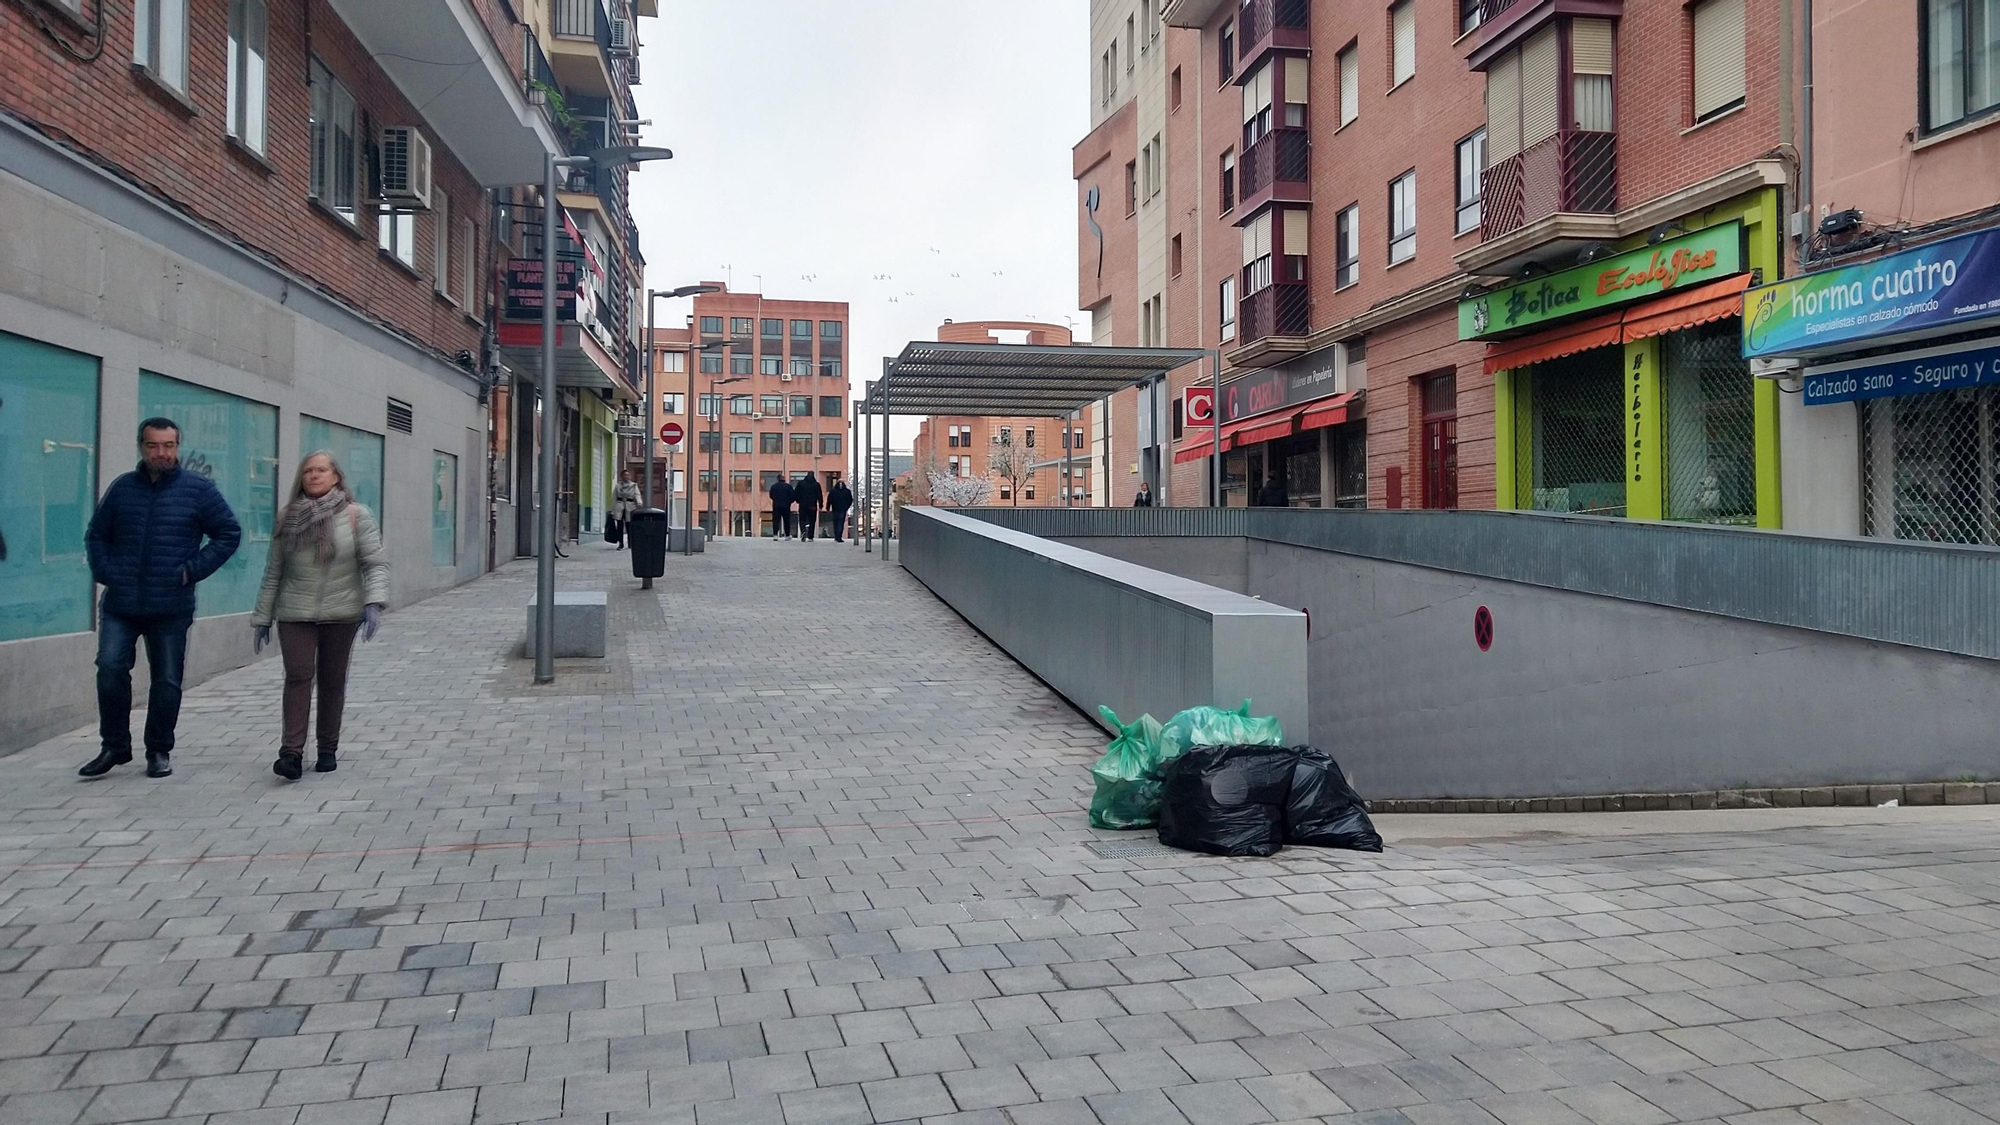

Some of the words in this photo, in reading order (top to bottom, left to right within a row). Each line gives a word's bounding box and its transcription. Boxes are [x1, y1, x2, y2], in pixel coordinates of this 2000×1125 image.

[1504, 281, 1581, 326] Botica
[1596, 248, 1717, 296] Ecológica
[1792, 281, 1863, 318] horma
[1872, 258, 1957, 301] cuatro
[1806, 317, 1855, 335] Especialistas
[1857, 314, 1868, 325] en
[1869, 306, 1902, 323] calzado
[1903, 299, 1939, 317] cómodo
[1954, 304, 1978, 315] Fundada
[1808, 374, 1857, 397] Calzado
[1863, 374, 1894, 391] sano
[1914, 363, 1967, 387] Seguro
[1974, 361, 1985, 382] y
